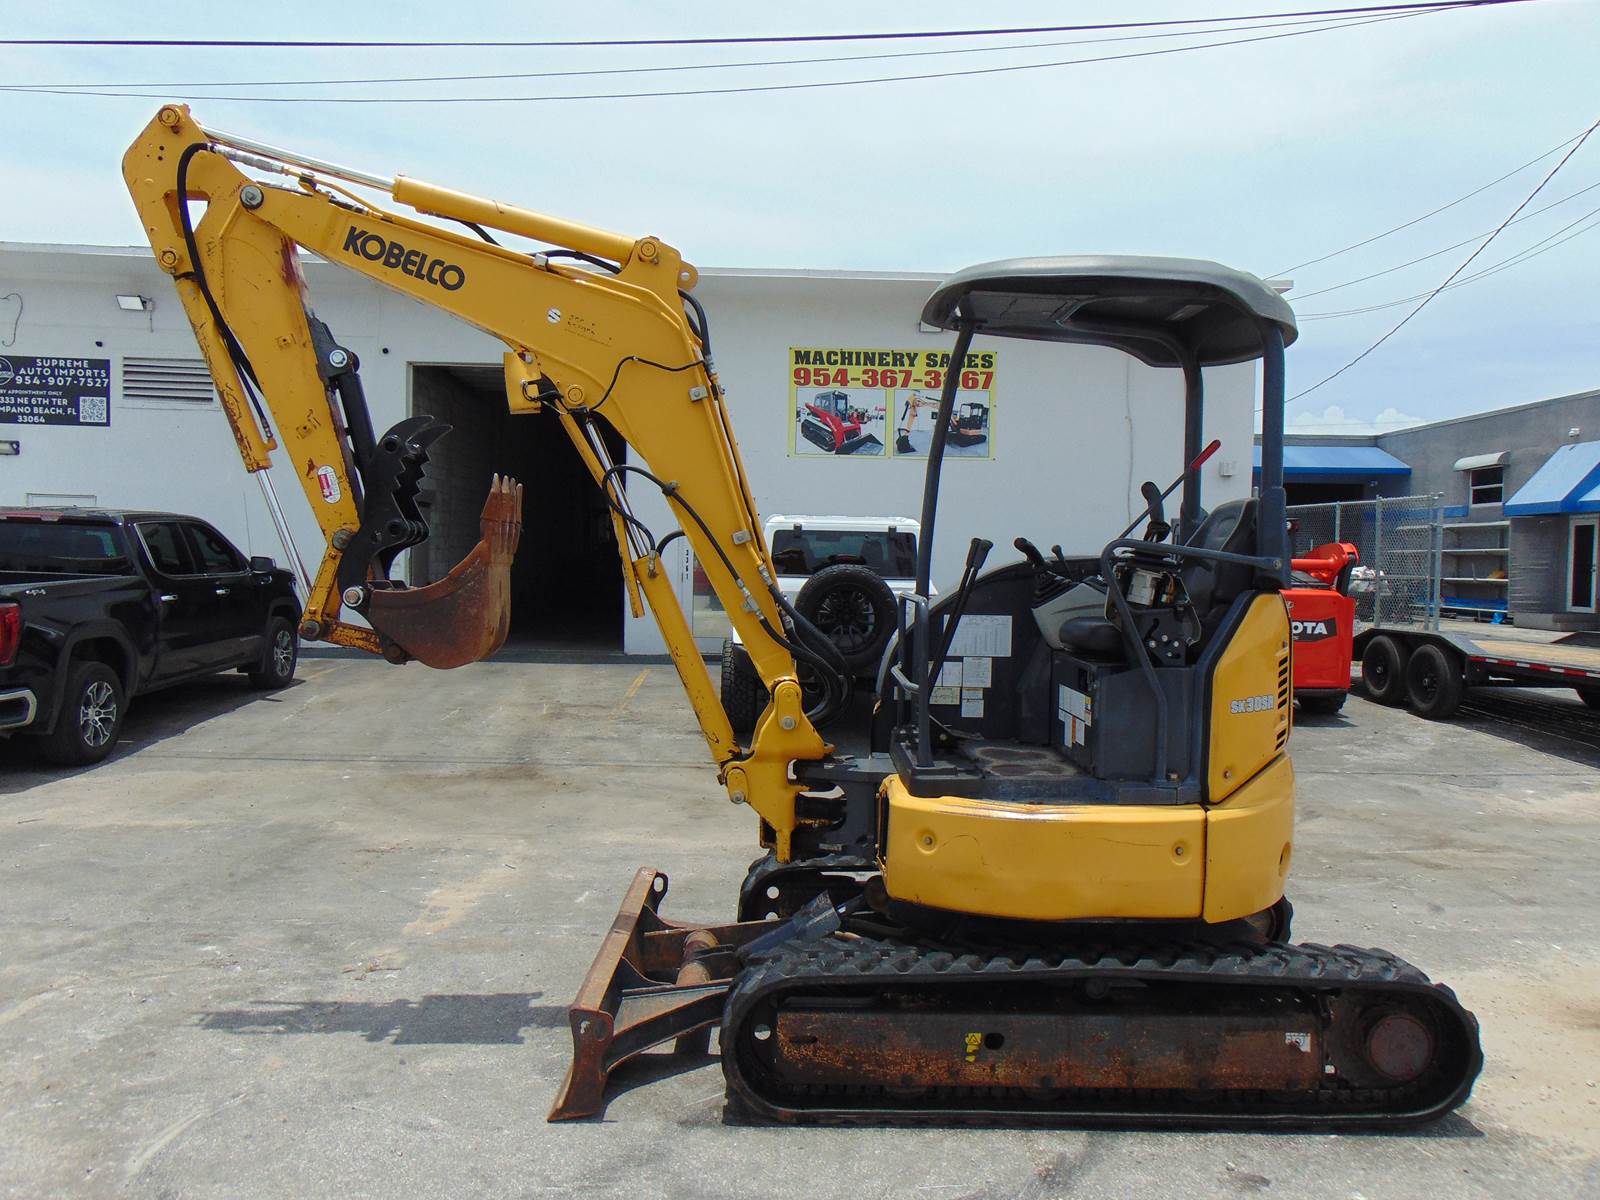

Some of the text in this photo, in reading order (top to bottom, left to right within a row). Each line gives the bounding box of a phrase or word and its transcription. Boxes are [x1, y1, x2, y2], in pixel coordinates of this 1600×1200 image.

[342, 225, 465, 291] KOBELCO
[36, 358, 89, 368] SUPREME
[794, 350, 994, 369] MACHINERY SAES
[19, 367, 51, 376] AUTO
[55, 368, 107, 378] IMPORTS
[793, 366, 994, 390] 954-367-367
[15, 376, 109, 387] 954-907-7527
[31, 397, 49, 405] 6TH
[51, 398, 68, 406] TER
[33, 406, 66, 415] BEACH,
[67, 407, 78, 415] FL
[17, 415, 46, 423] 33064
